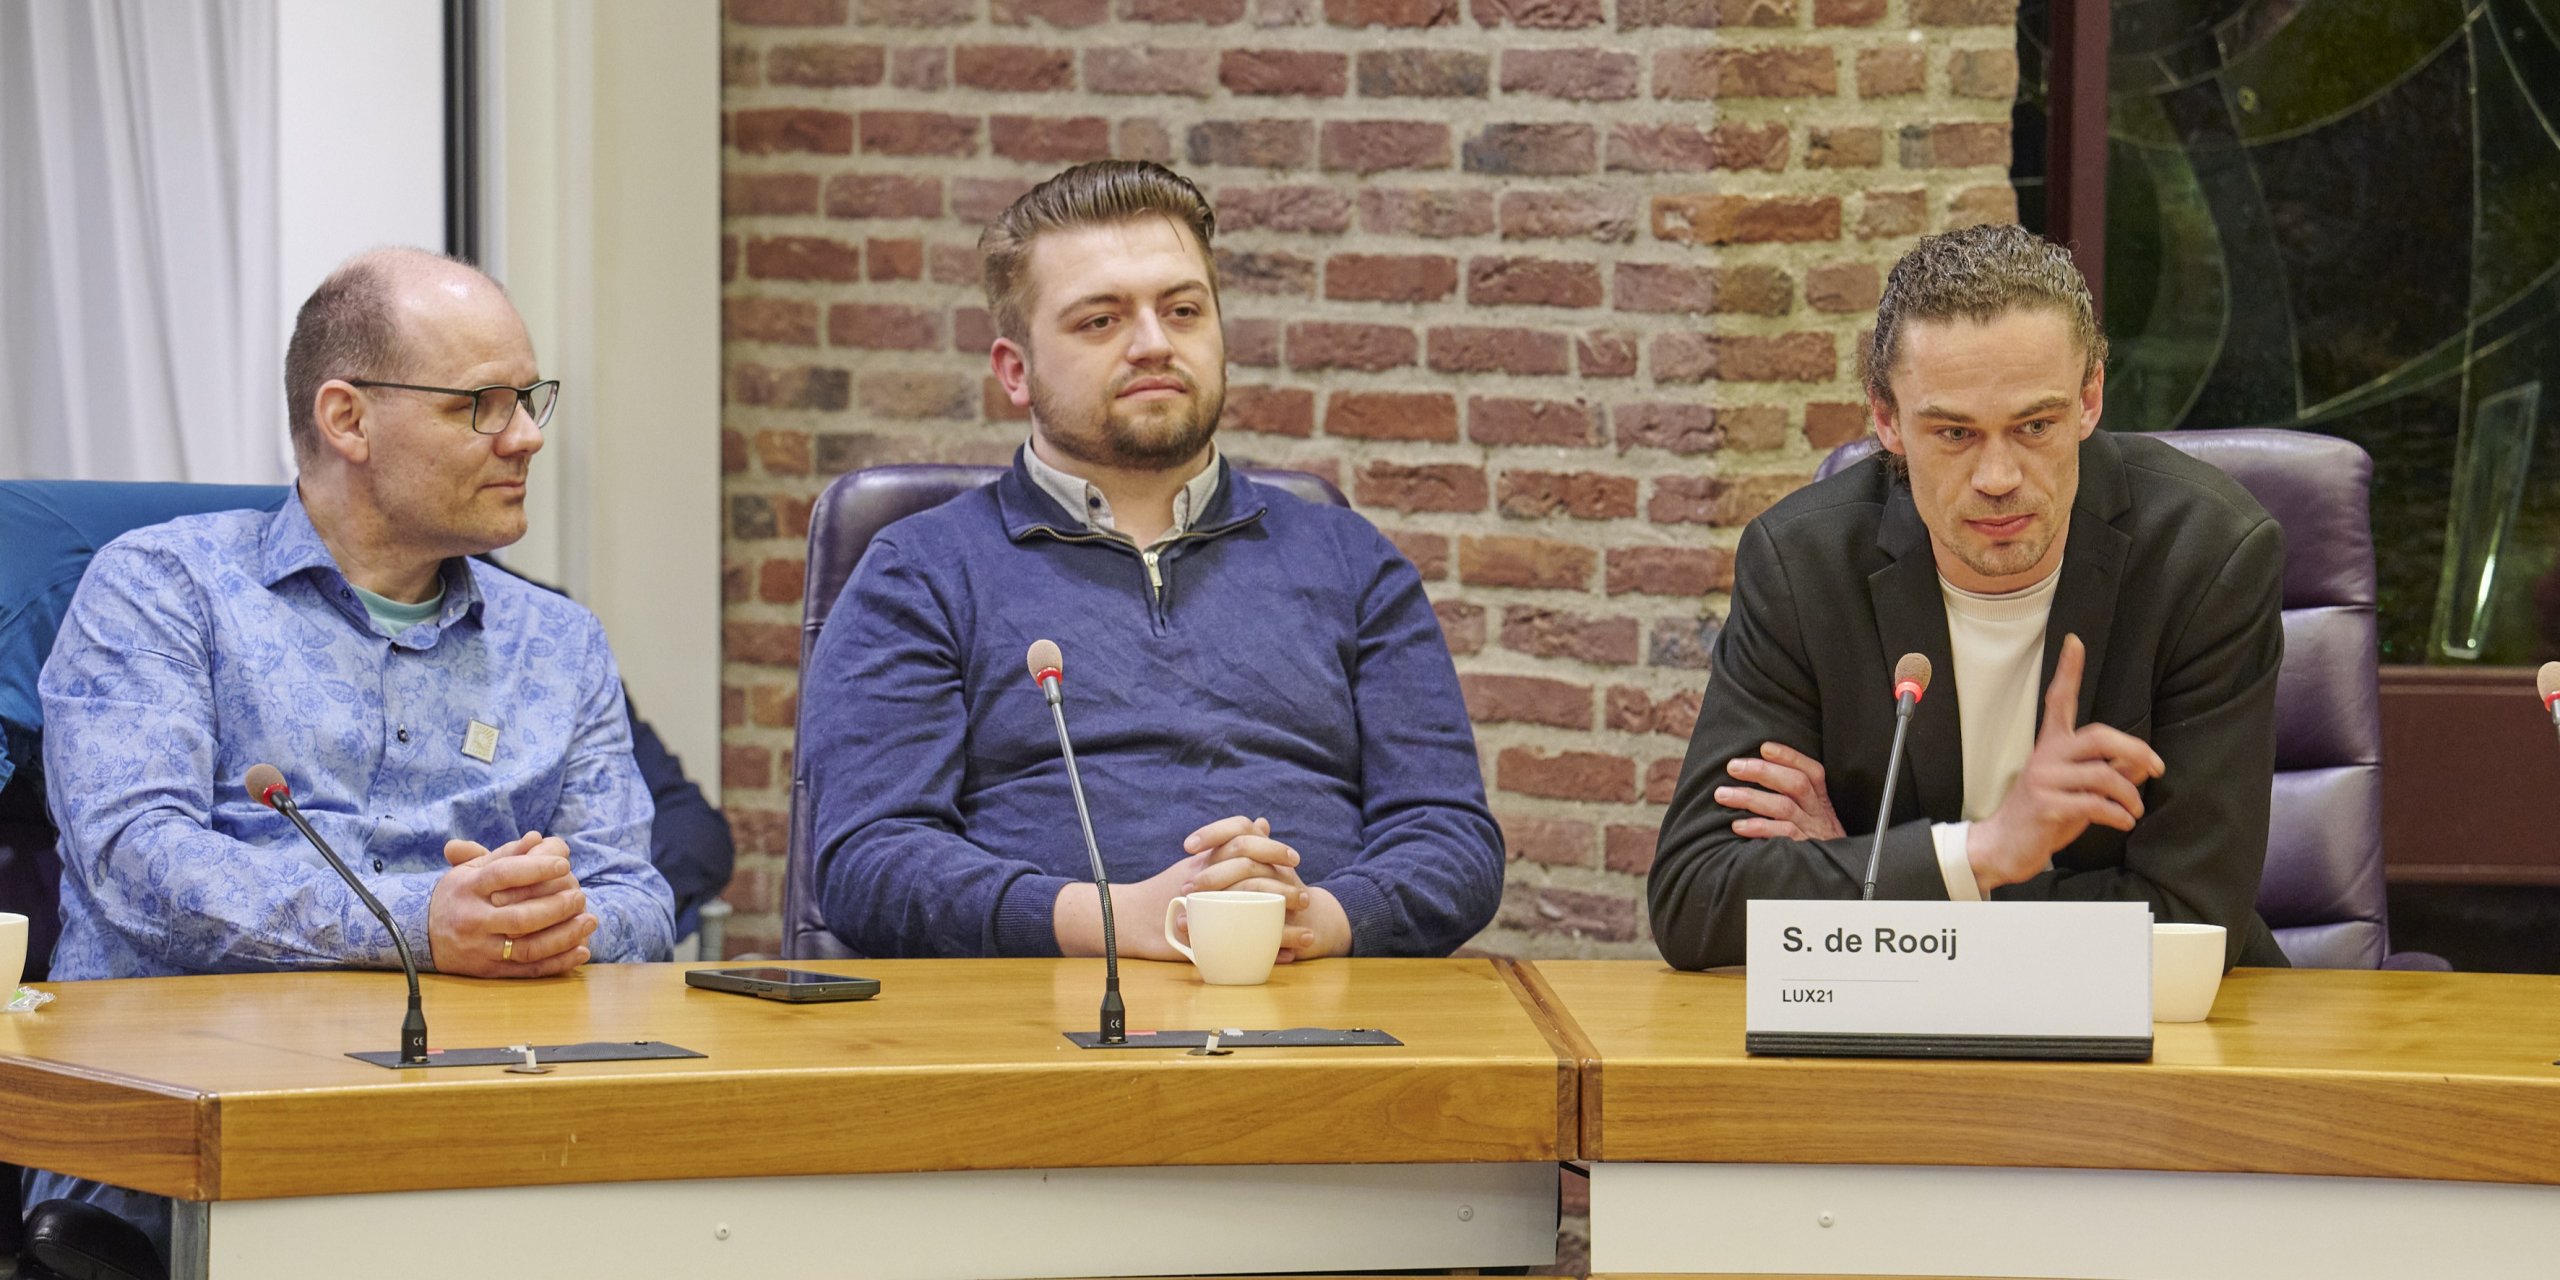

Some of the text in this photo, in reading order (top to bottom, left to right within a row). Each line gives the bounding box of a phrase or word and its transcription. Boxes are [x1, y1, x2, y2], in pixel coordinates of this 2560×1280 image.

[1782, 926, 1958, 961] S. de Rooij
[1782, 989, 1833, 1003] LUX21
